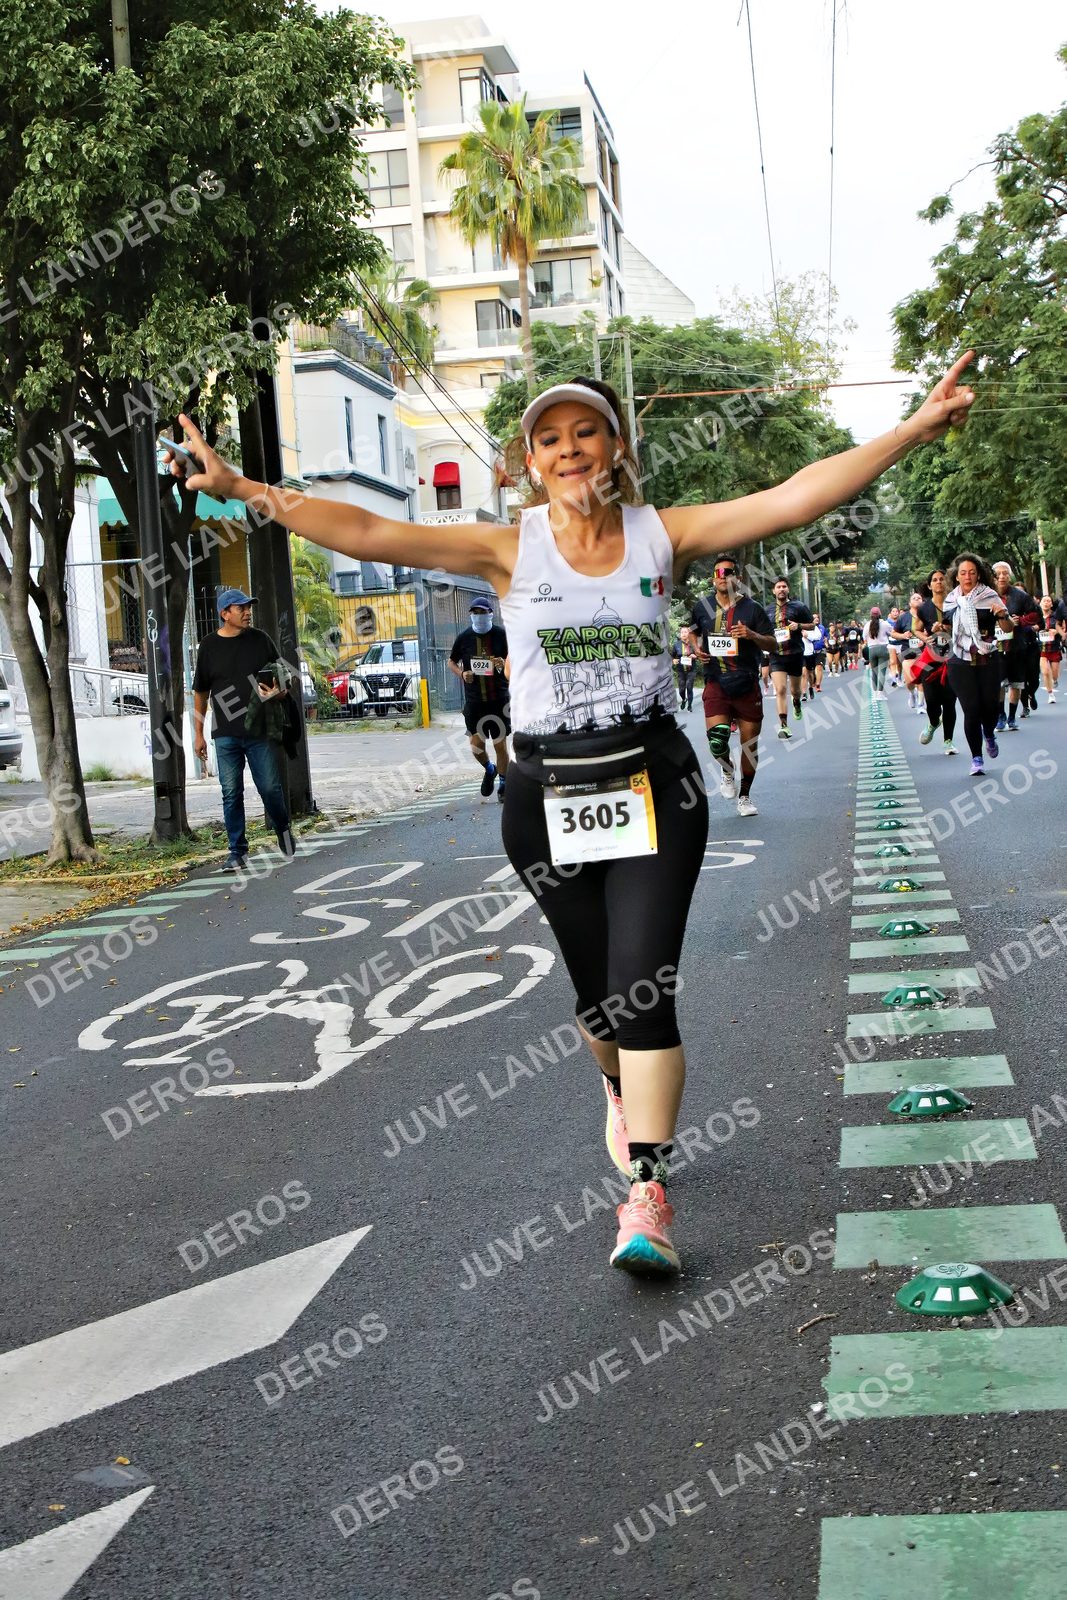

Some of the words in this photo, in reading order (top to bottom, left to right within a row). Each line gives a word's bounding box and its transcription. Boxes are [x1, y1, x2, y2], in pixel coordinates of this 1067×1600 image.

[711, 640, 732, 648] 4296
[472, 661, 489, 669] 6924
[632, 776, 646, 787] 5K
[560, 801, 631, 834] 3605
